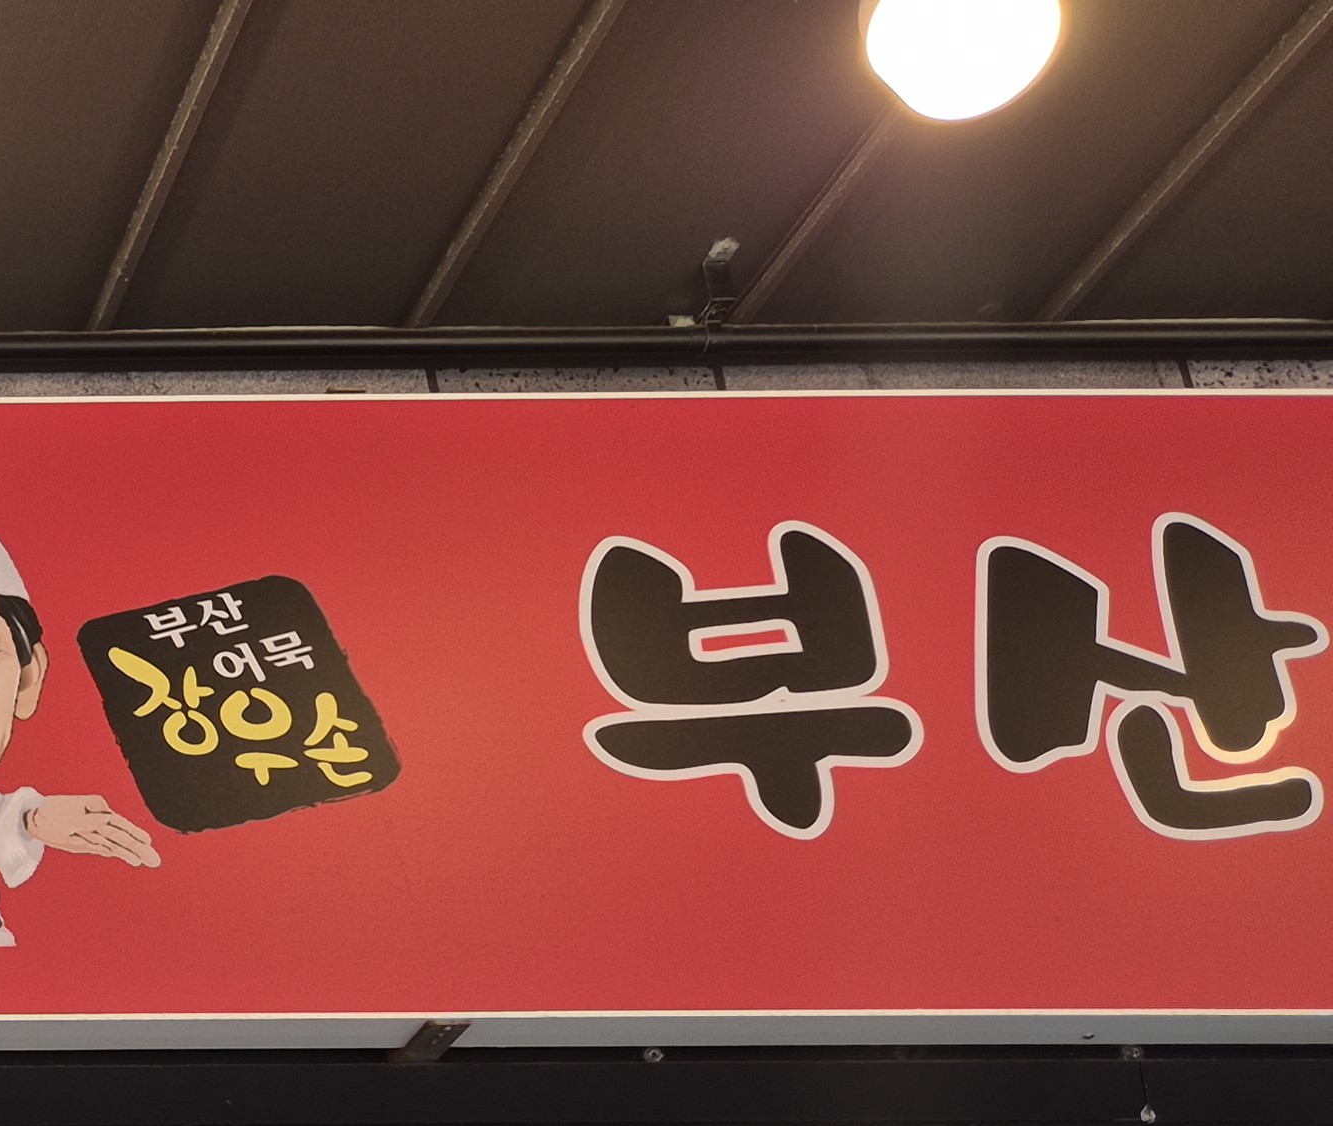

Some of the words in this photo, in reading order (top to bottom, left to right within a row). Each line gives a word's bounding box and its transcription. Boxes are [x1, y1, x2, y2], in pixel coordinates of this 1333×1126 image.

[143, 592, 250, 649] 부산
[212, 630, 314, 683] 어묵
[107, 646, 373, 788] 장우손
[579, 512, 1329, 841] 부산
